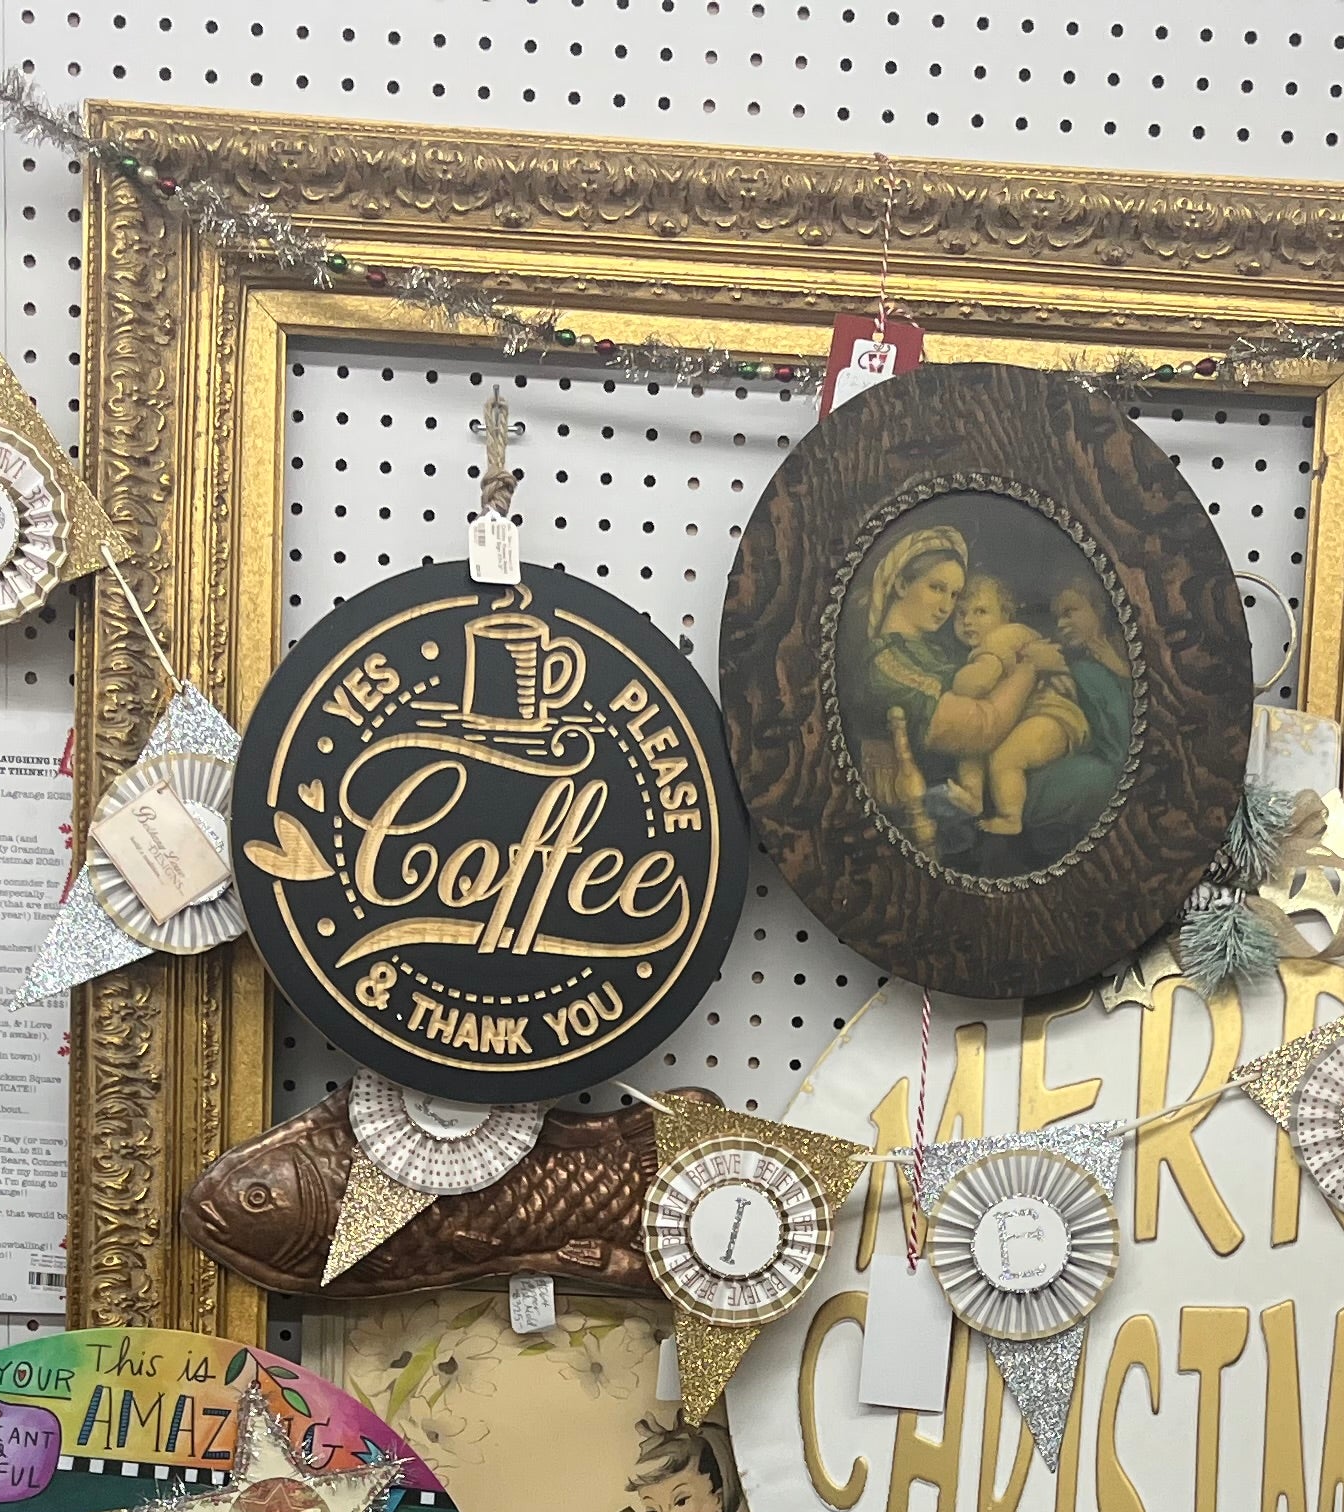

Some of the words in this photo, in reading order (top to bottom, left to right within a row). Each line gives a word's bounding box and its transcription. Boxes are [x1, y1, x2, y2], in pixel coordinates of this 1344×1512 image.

[323, 651, 400, 727] YES
[610, 679, 701, 834] PLEASE
[339, 735, 690, 957] Coffee
[356, 961, 398, 1011] &
[405, 990, 533, 1056] THANK
[543, 981, 625, 1047] YOU
[994, 1207, 1048, 1281] E
[86, 1335, 158, 1378] This
[179, 1351, 216, 1384] is
